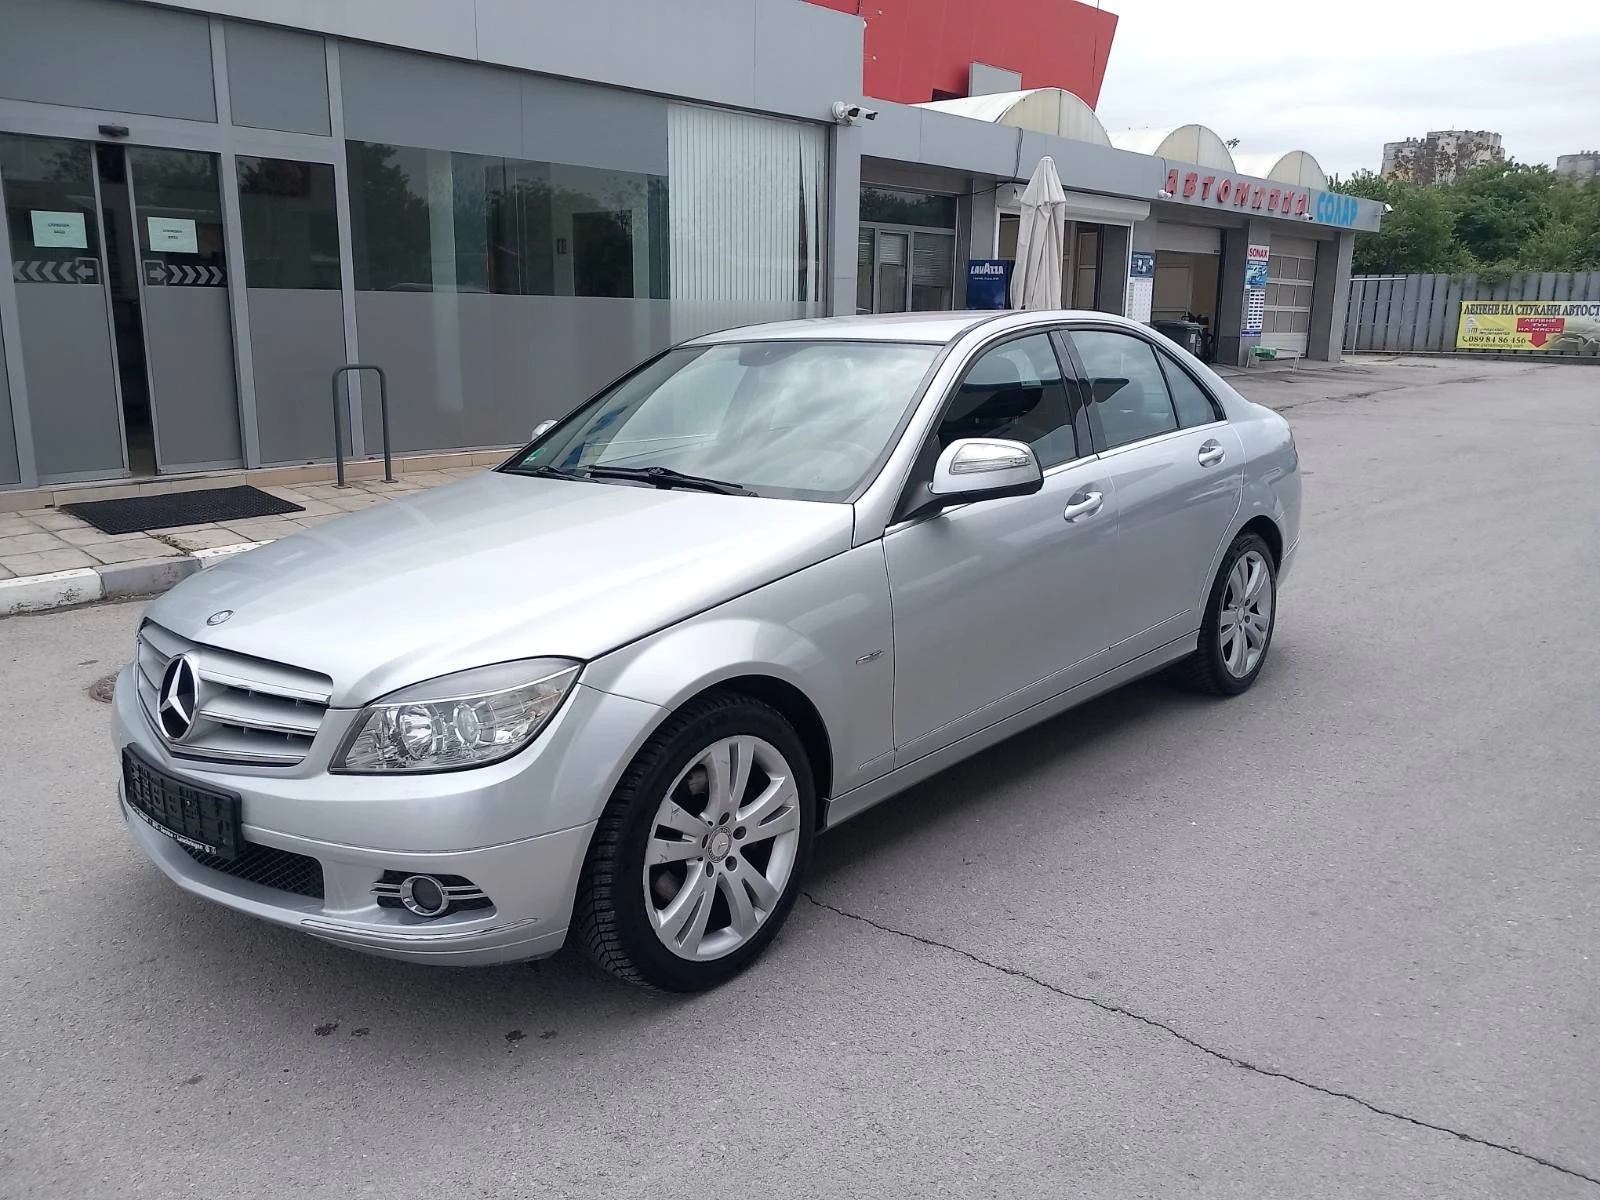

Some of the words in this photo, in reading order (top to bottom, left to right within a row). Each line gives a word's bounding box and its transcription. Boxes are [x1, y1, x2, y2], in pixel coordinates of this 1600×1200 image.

[1166, 167, 1306, 215] АВТОМИВКА
[1316, 191, 1358, 226] СОЛАР
[1249, 247, 1268, 258] SONAX
[970, 262, 1004, 274] LAVAZZA
[1464, 304, 1500, 315] ЛЕПЕНЕ
[1501, 304, 1514, 315] НА
[1515, 304, 1561, 316] СПУКАНИ
